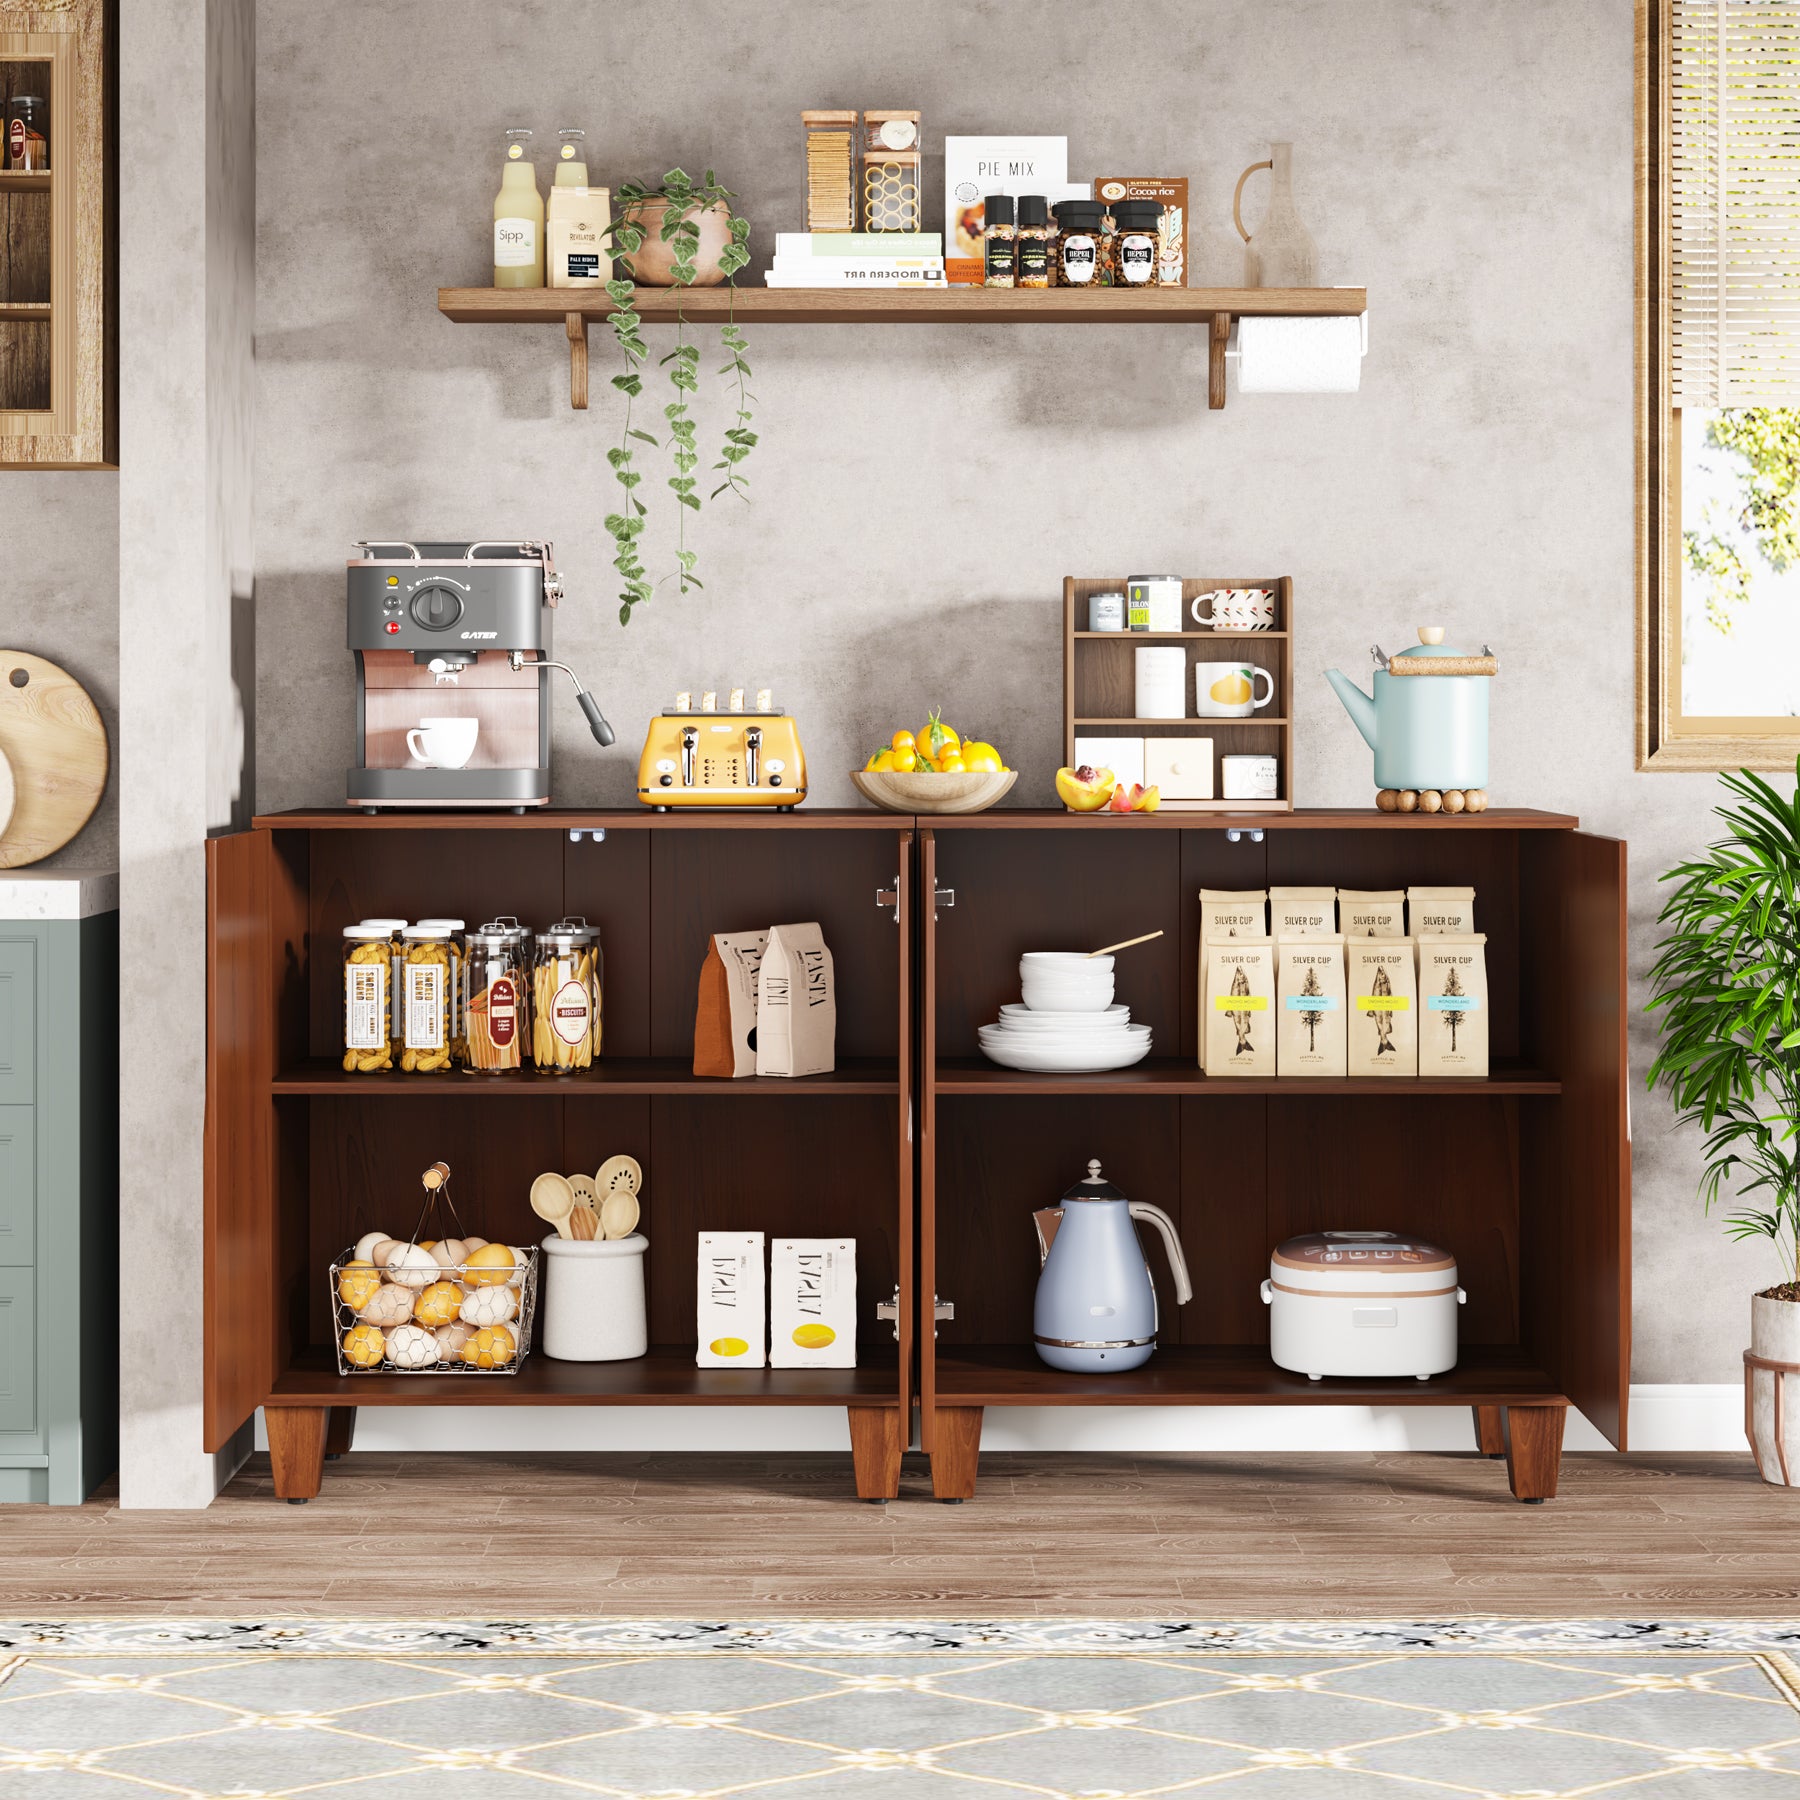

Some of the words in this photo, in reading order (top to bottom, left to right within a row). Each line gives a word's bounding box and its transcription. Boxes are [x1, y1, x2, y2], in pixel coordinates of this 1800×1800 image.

[978, 161, 1000, 176] PIE
[1009, 161, 1034, 176] MIX
[1129, 187, 1157, 196] Cocoa
[1159, 187, 1175, 196] rice
[499, 229, 524, 244] Sipp
[569, 233, 596, 241] REVELATOR
[460, 631, 498, 640] GATER
[1214, 916, 1238, 925] SILVER
[1239, 916, 1254, 925] CUP
[1284, 916, 1307, 926] SILVER
[1309, 916, 1324, 926] CUP
[1353, 916, 1376, 925] SILVER
[1377, 916, 1392, 925] CUP
[1423, 916, 1446, 926] SILVER
[1447, 916, 1462, 926] CUP
[1221, 956, 1244, 964] SILVER
[1246, 956, 1261, 964] CUP
[1292, 956, 1316, 964] SILVER
[1317, 956, 1332, 964] CUP
[1362, 956, 1386, 964] SILVER
[1387, 956, 1402, 964] CUP
[1433, 956, 1457, 964] SILVER
[1458, 956, 1473, 964] CUP
[805, 950, 827, 1007] PASTA
[355, 971, 365, 1001] ALMOND
[365, 971, 375, 1001] SMOKED
[415, 971, 424, 1001] ALMOND
[424, 971, 434, 1001] SMOKED
[561, 1008, 585, 1017] BISCUITS
